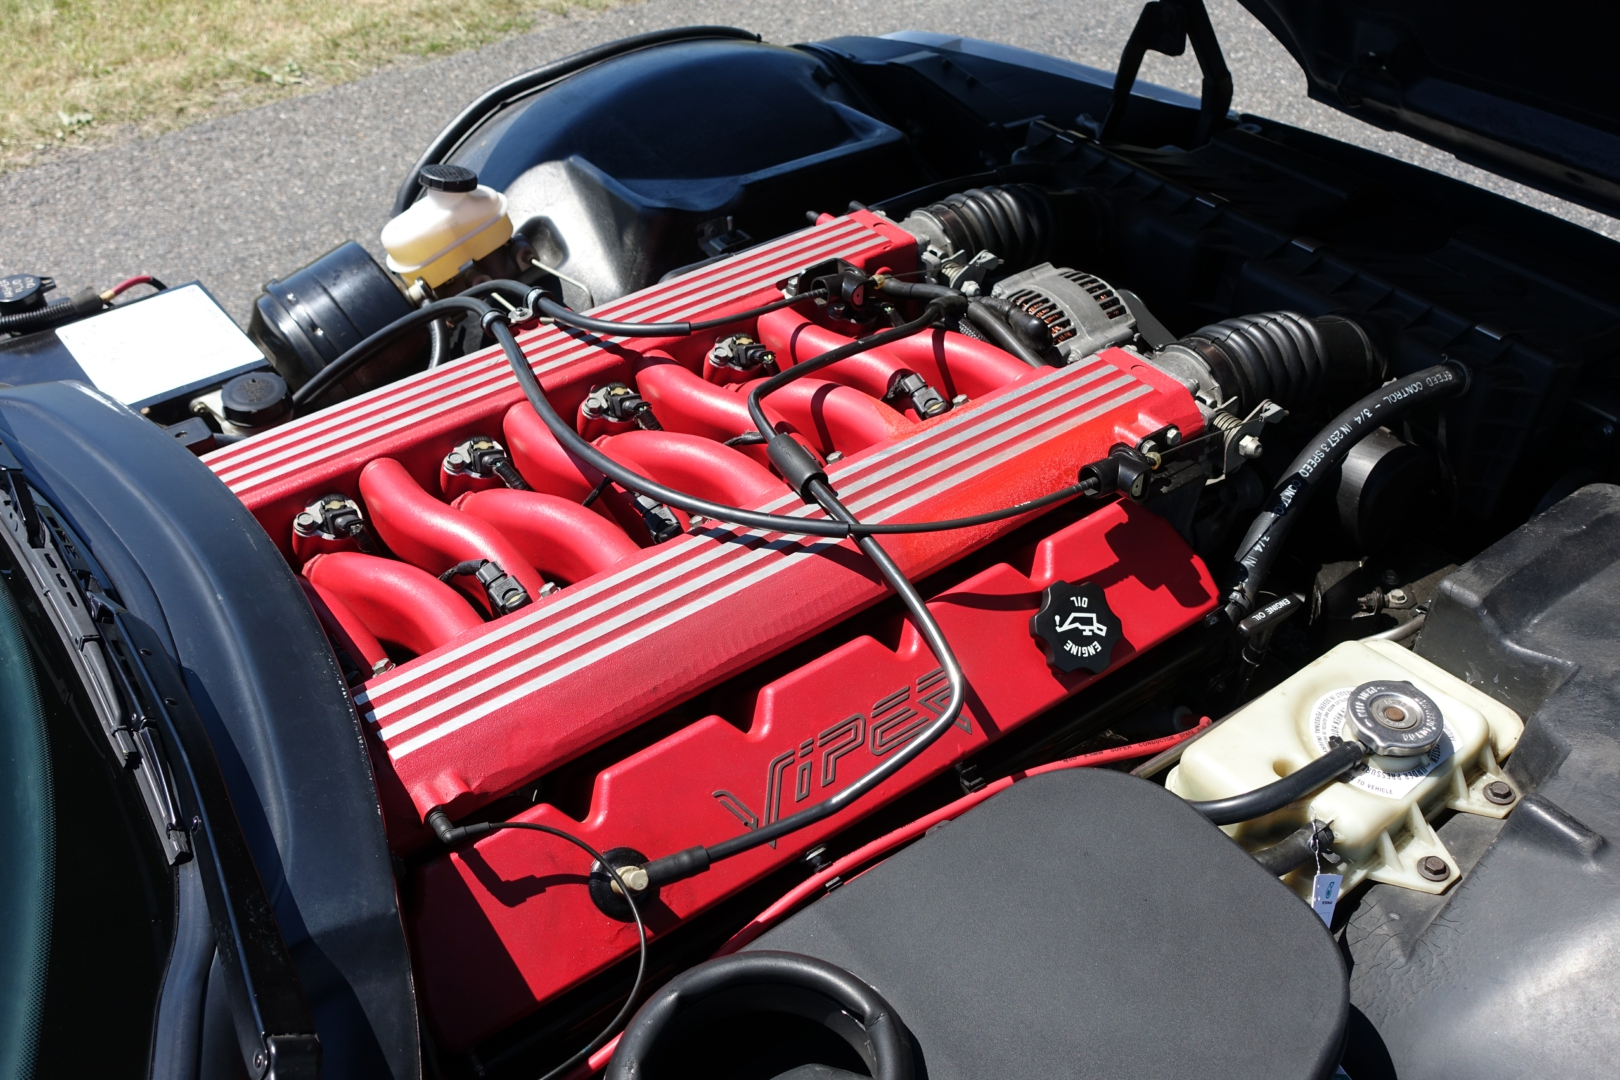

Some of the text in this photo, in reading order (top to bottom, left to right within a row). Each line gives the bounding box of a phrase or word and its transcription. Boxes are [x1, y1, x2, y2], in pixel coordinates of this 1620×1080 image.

[1383, 381, 1423, 405] CONTROL
[1354, 409, 1373, 425] 3/4
[1342, 422, 1354, 435] IN
[1299, 450, 1326, 478] SPEED
[1070, 596, 1088, 608] OIL
[1252, 598, 1291, 623] ENGINE OIL
[1063, 639, 1102, 657] ENGINE
[1314, 711, 1323, 734] PERSONAL
[1138, 736, 1175, 747] CONDUCTOR
[1360, 765, 1402, 781] PRESSURE
[1402, 766, 1428, 780] UNDER
[1356, 778, 1365, 786] TO
[1367, 783, 1393, 795] VEHICLE
